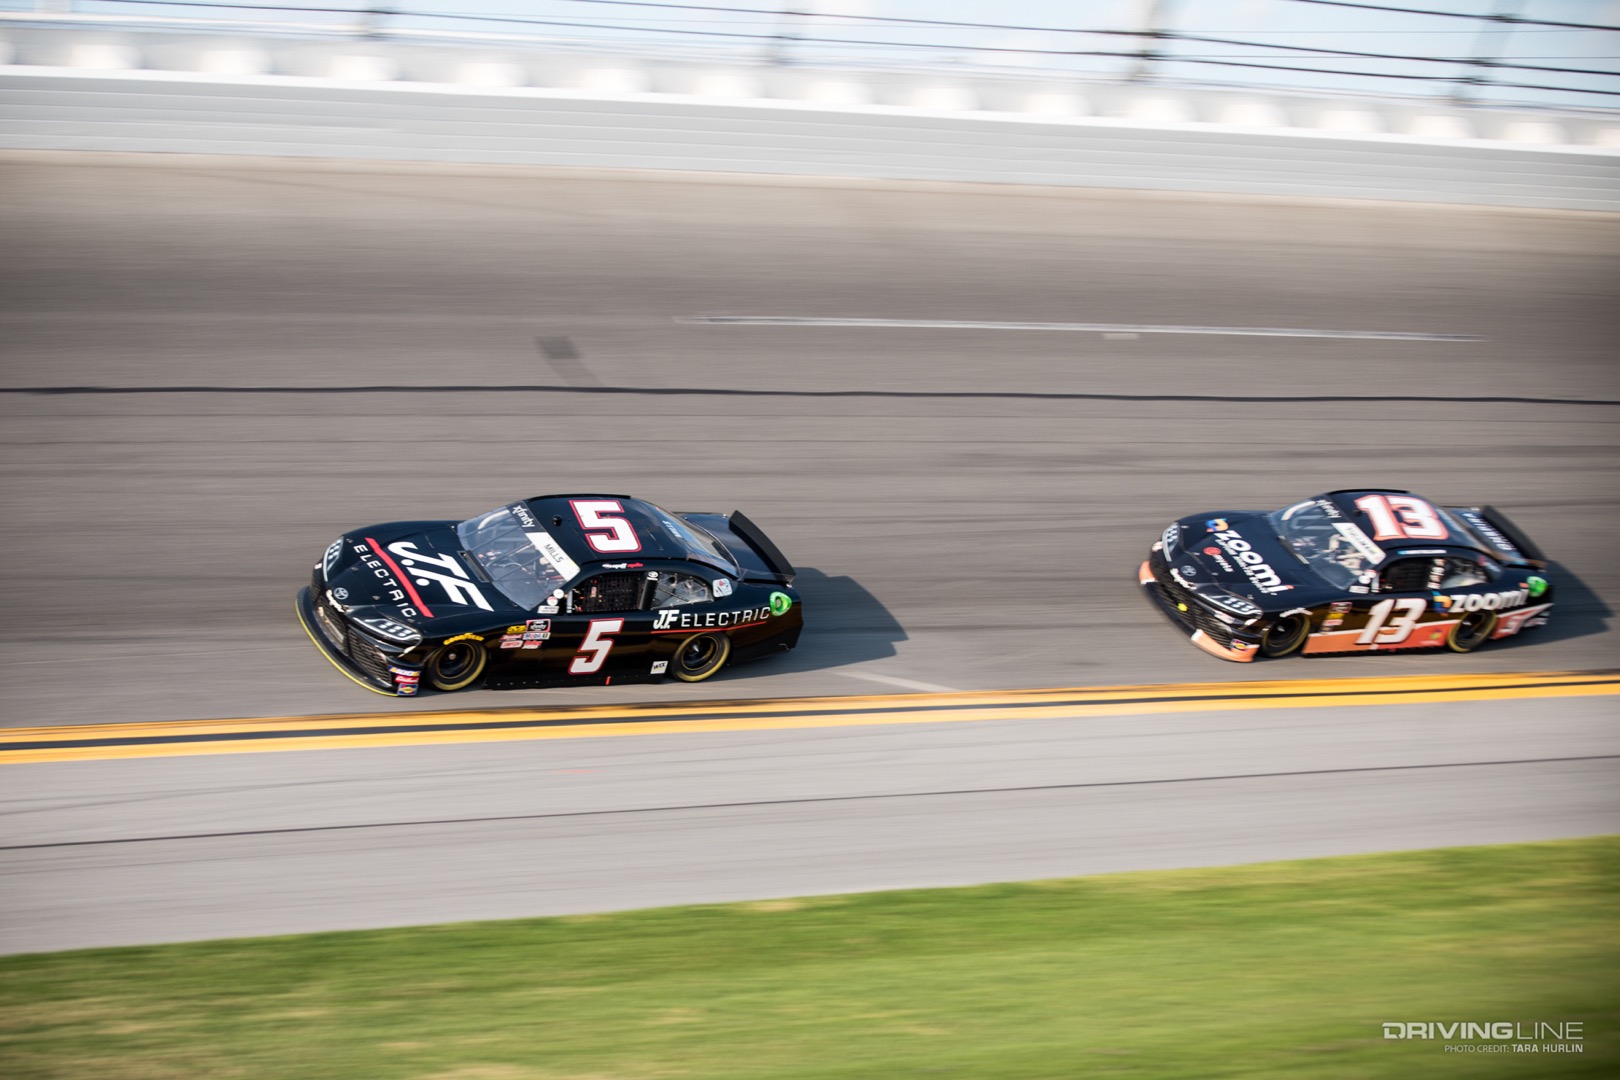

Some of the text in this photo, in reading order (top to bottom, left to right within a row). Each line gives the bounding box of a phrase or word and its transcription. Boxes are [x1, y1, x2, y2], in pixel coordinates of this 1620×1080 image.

[512, 505, 535, 528] xfinity
[569, 500, 642, 554] 5
[1355, 494, 1449, 541] 13
[543, 543, 564, 563] MILLS
[353, 544, 417, 619] ELECTRIC
[681, 606, 771, 628] ELECTRIC
[1354, 597, 1428, 645] 13
[568, 617, 625, 675] 5
